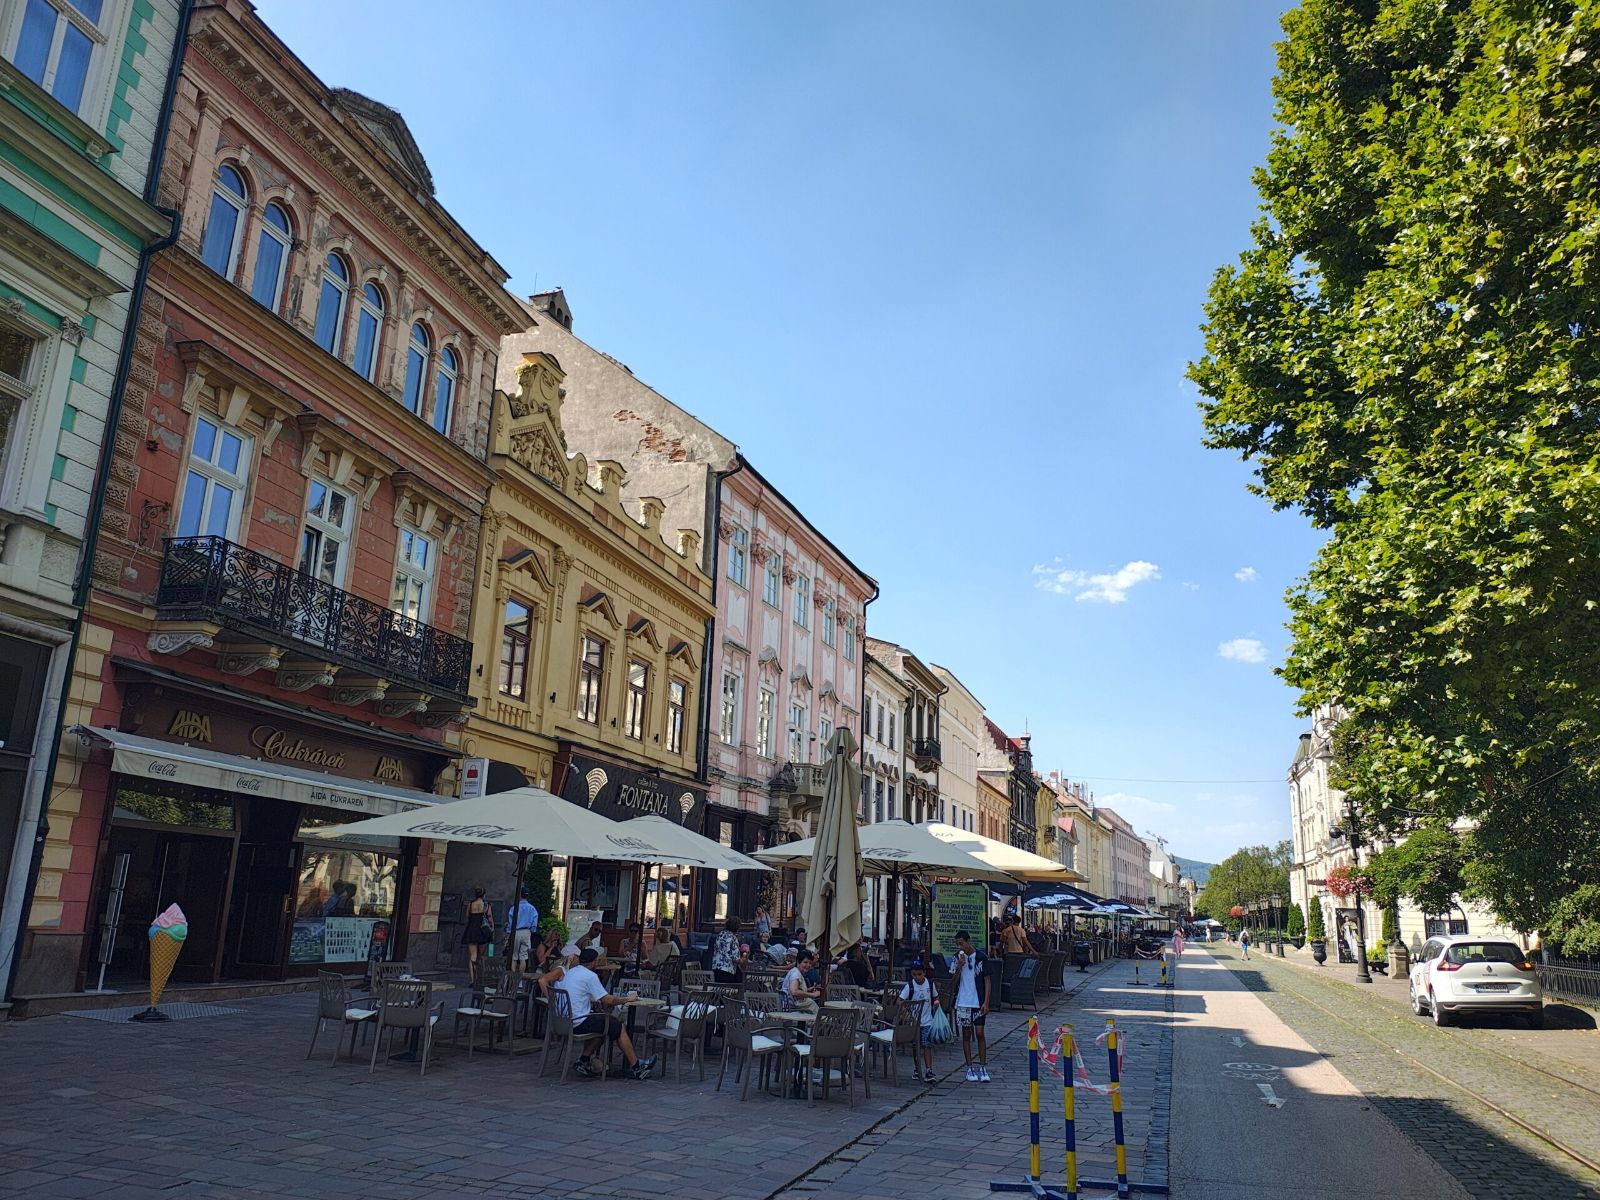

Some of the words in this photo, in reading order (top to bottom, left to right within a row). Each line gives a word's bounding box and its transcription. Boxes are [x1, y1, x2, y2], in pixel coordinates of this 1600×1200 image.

[169, 710, 212, 743] AIDA
[252, 725, 346, 769] Cukráreň
[376, 756, 405, 782] AIDA
[310, 791, 327, 801] AIDA
[618, 785, 669, 814] FONTANA
